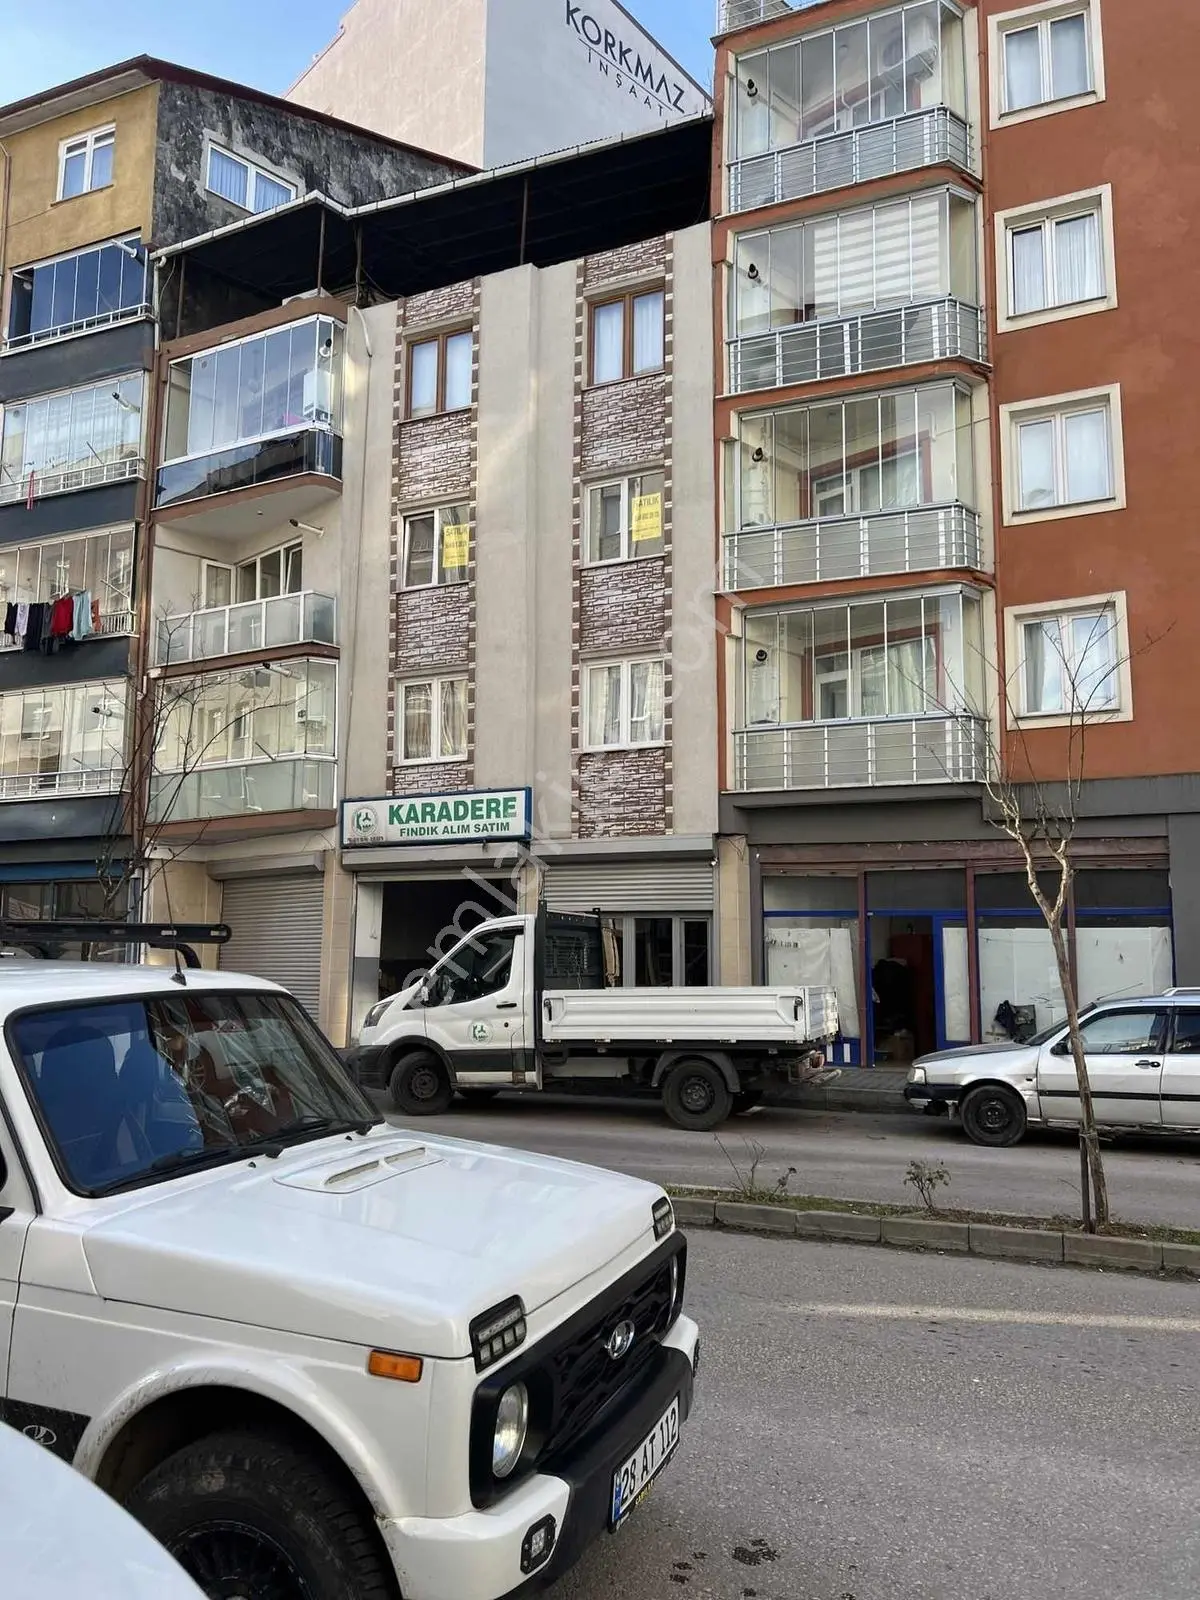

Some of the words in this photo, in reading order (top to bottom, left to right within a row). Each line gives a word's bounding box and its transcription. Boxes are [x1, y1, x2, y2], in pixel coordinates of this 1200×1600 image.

[565, 0, 685, 114] KORKMAZ
[388, 796, 517, 826] KARADERE
[400, 827, 439, 837] FINDIK
[442, 824, 470, 834] ALIM
[474, 822, 510, 833] SATIM
[621, 1458, 636, 1504] 28
[641, 1433, 656, 1482] AT
[660, 1407, 676, 1456] 112
